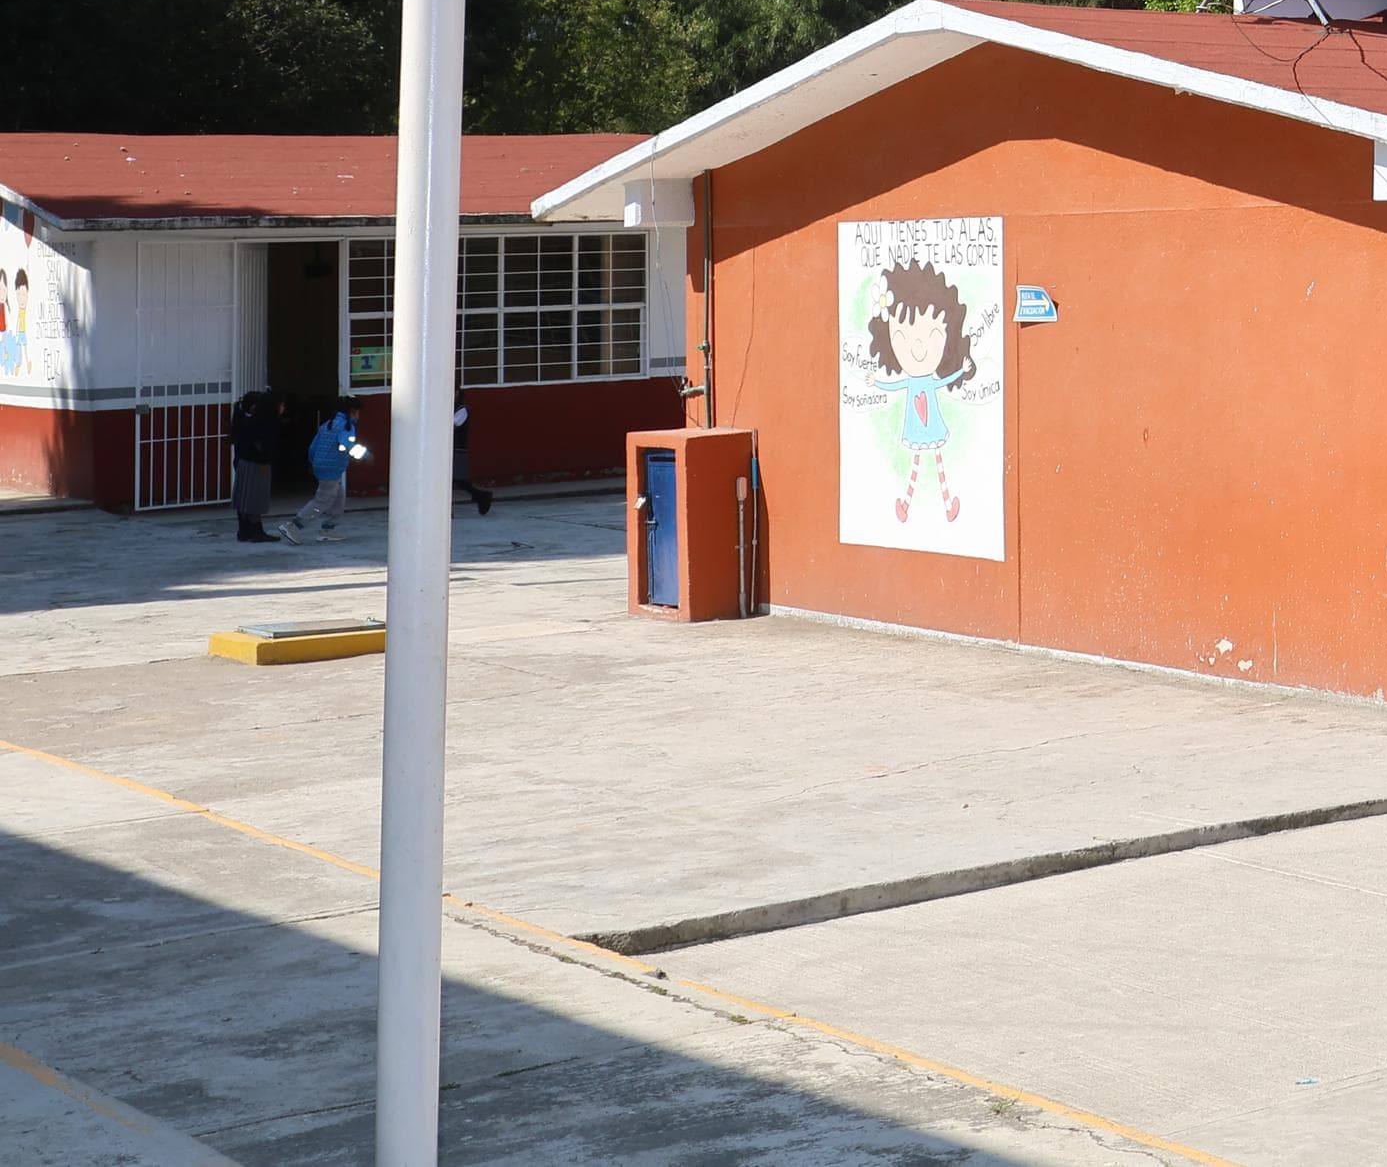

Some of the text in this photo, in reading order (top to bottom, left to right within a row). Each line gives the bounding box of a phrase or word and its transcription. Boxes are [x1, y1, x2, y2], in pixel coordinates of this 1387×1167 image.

[856, 218, 883, 245] AQUÍ
[888, 220, 928, 243] TIENES
[932, 219, 955, 241] TUS
[860, 243, 999, 268] QUE NADIE TE LAS CORTE
[969, 303, 1000, 347] Soy libre
[842, 342, 878, 372] Soy fuerte
[842, 386, 856, 409] Soy
[962, 382, 977, 401] Soy
